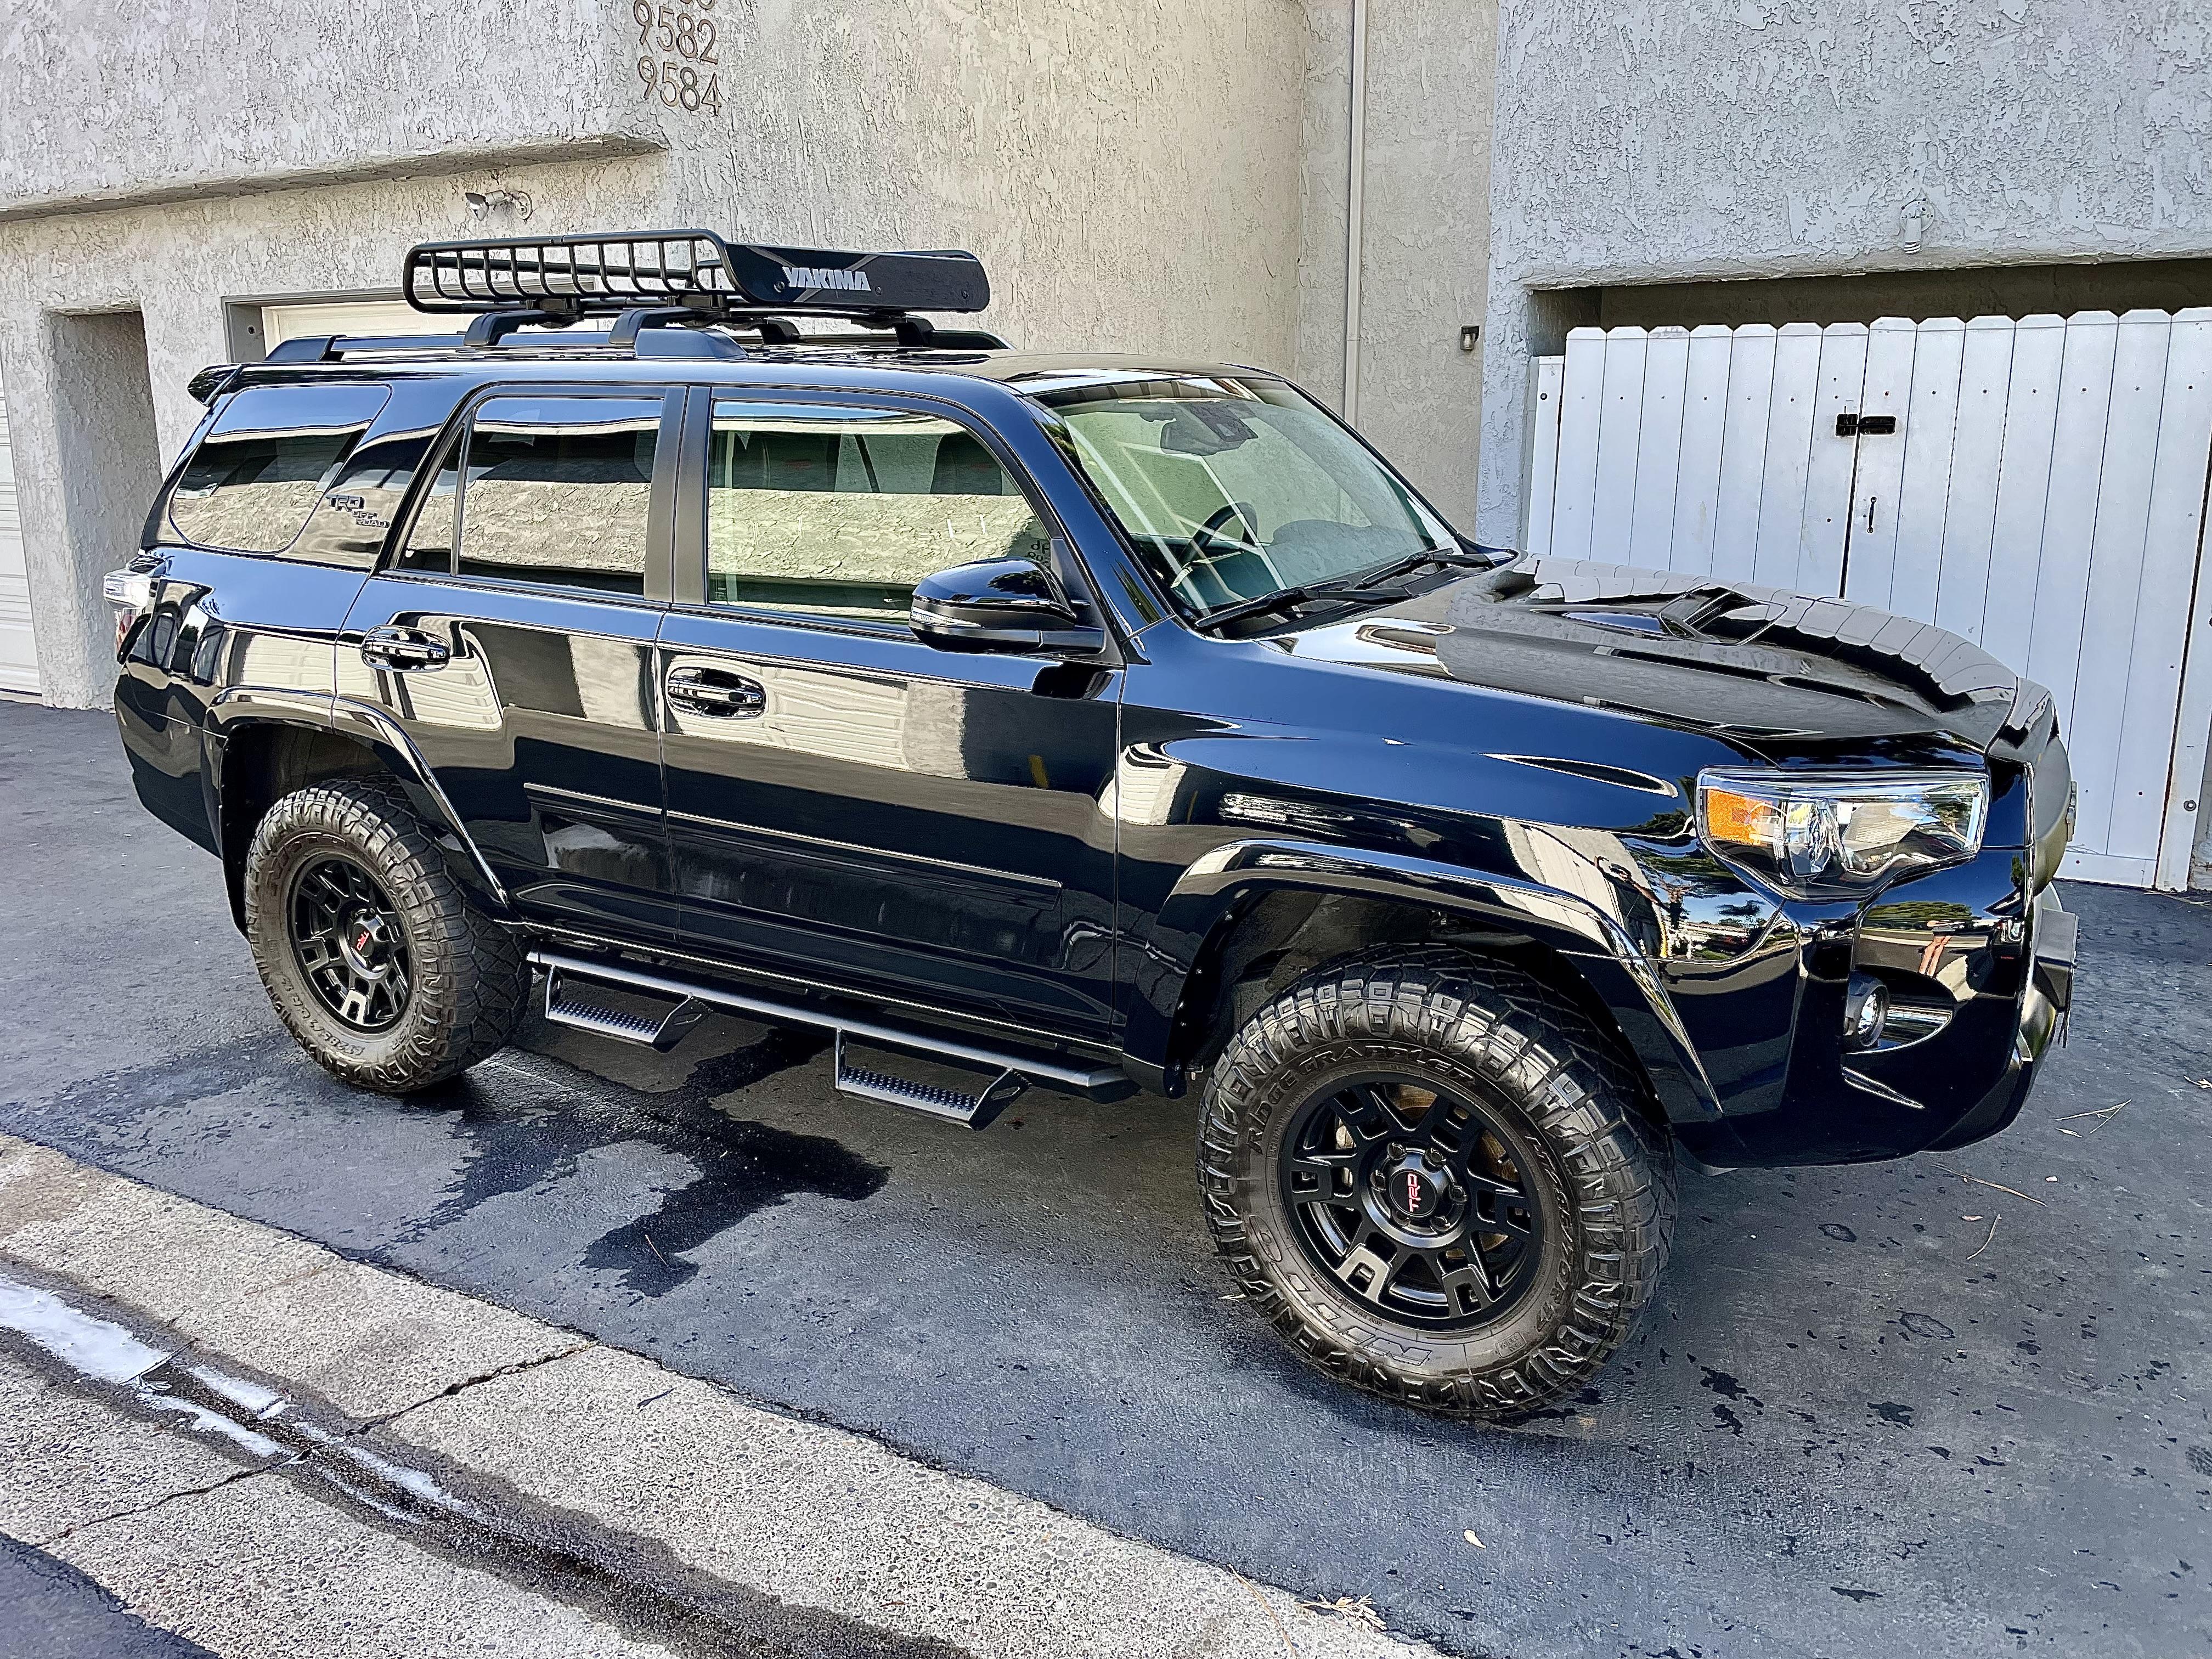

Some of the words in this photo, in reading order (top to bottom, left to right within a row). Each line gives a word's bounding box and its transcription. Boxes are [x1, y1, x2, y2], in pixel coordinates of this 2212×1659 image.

[633, 0, 719, 65] 9582
[637, 55, 723, 117] 9584
[782, 266, 871, 291] YAKIMA
[356, 518, 390, 528] ROAD
[1246, 1069, 1297, 1154] RIDGE
[1299, 1045, 1475, 1084] GRAPPLER
[1407, 1172, 1422, 1212] TRD
